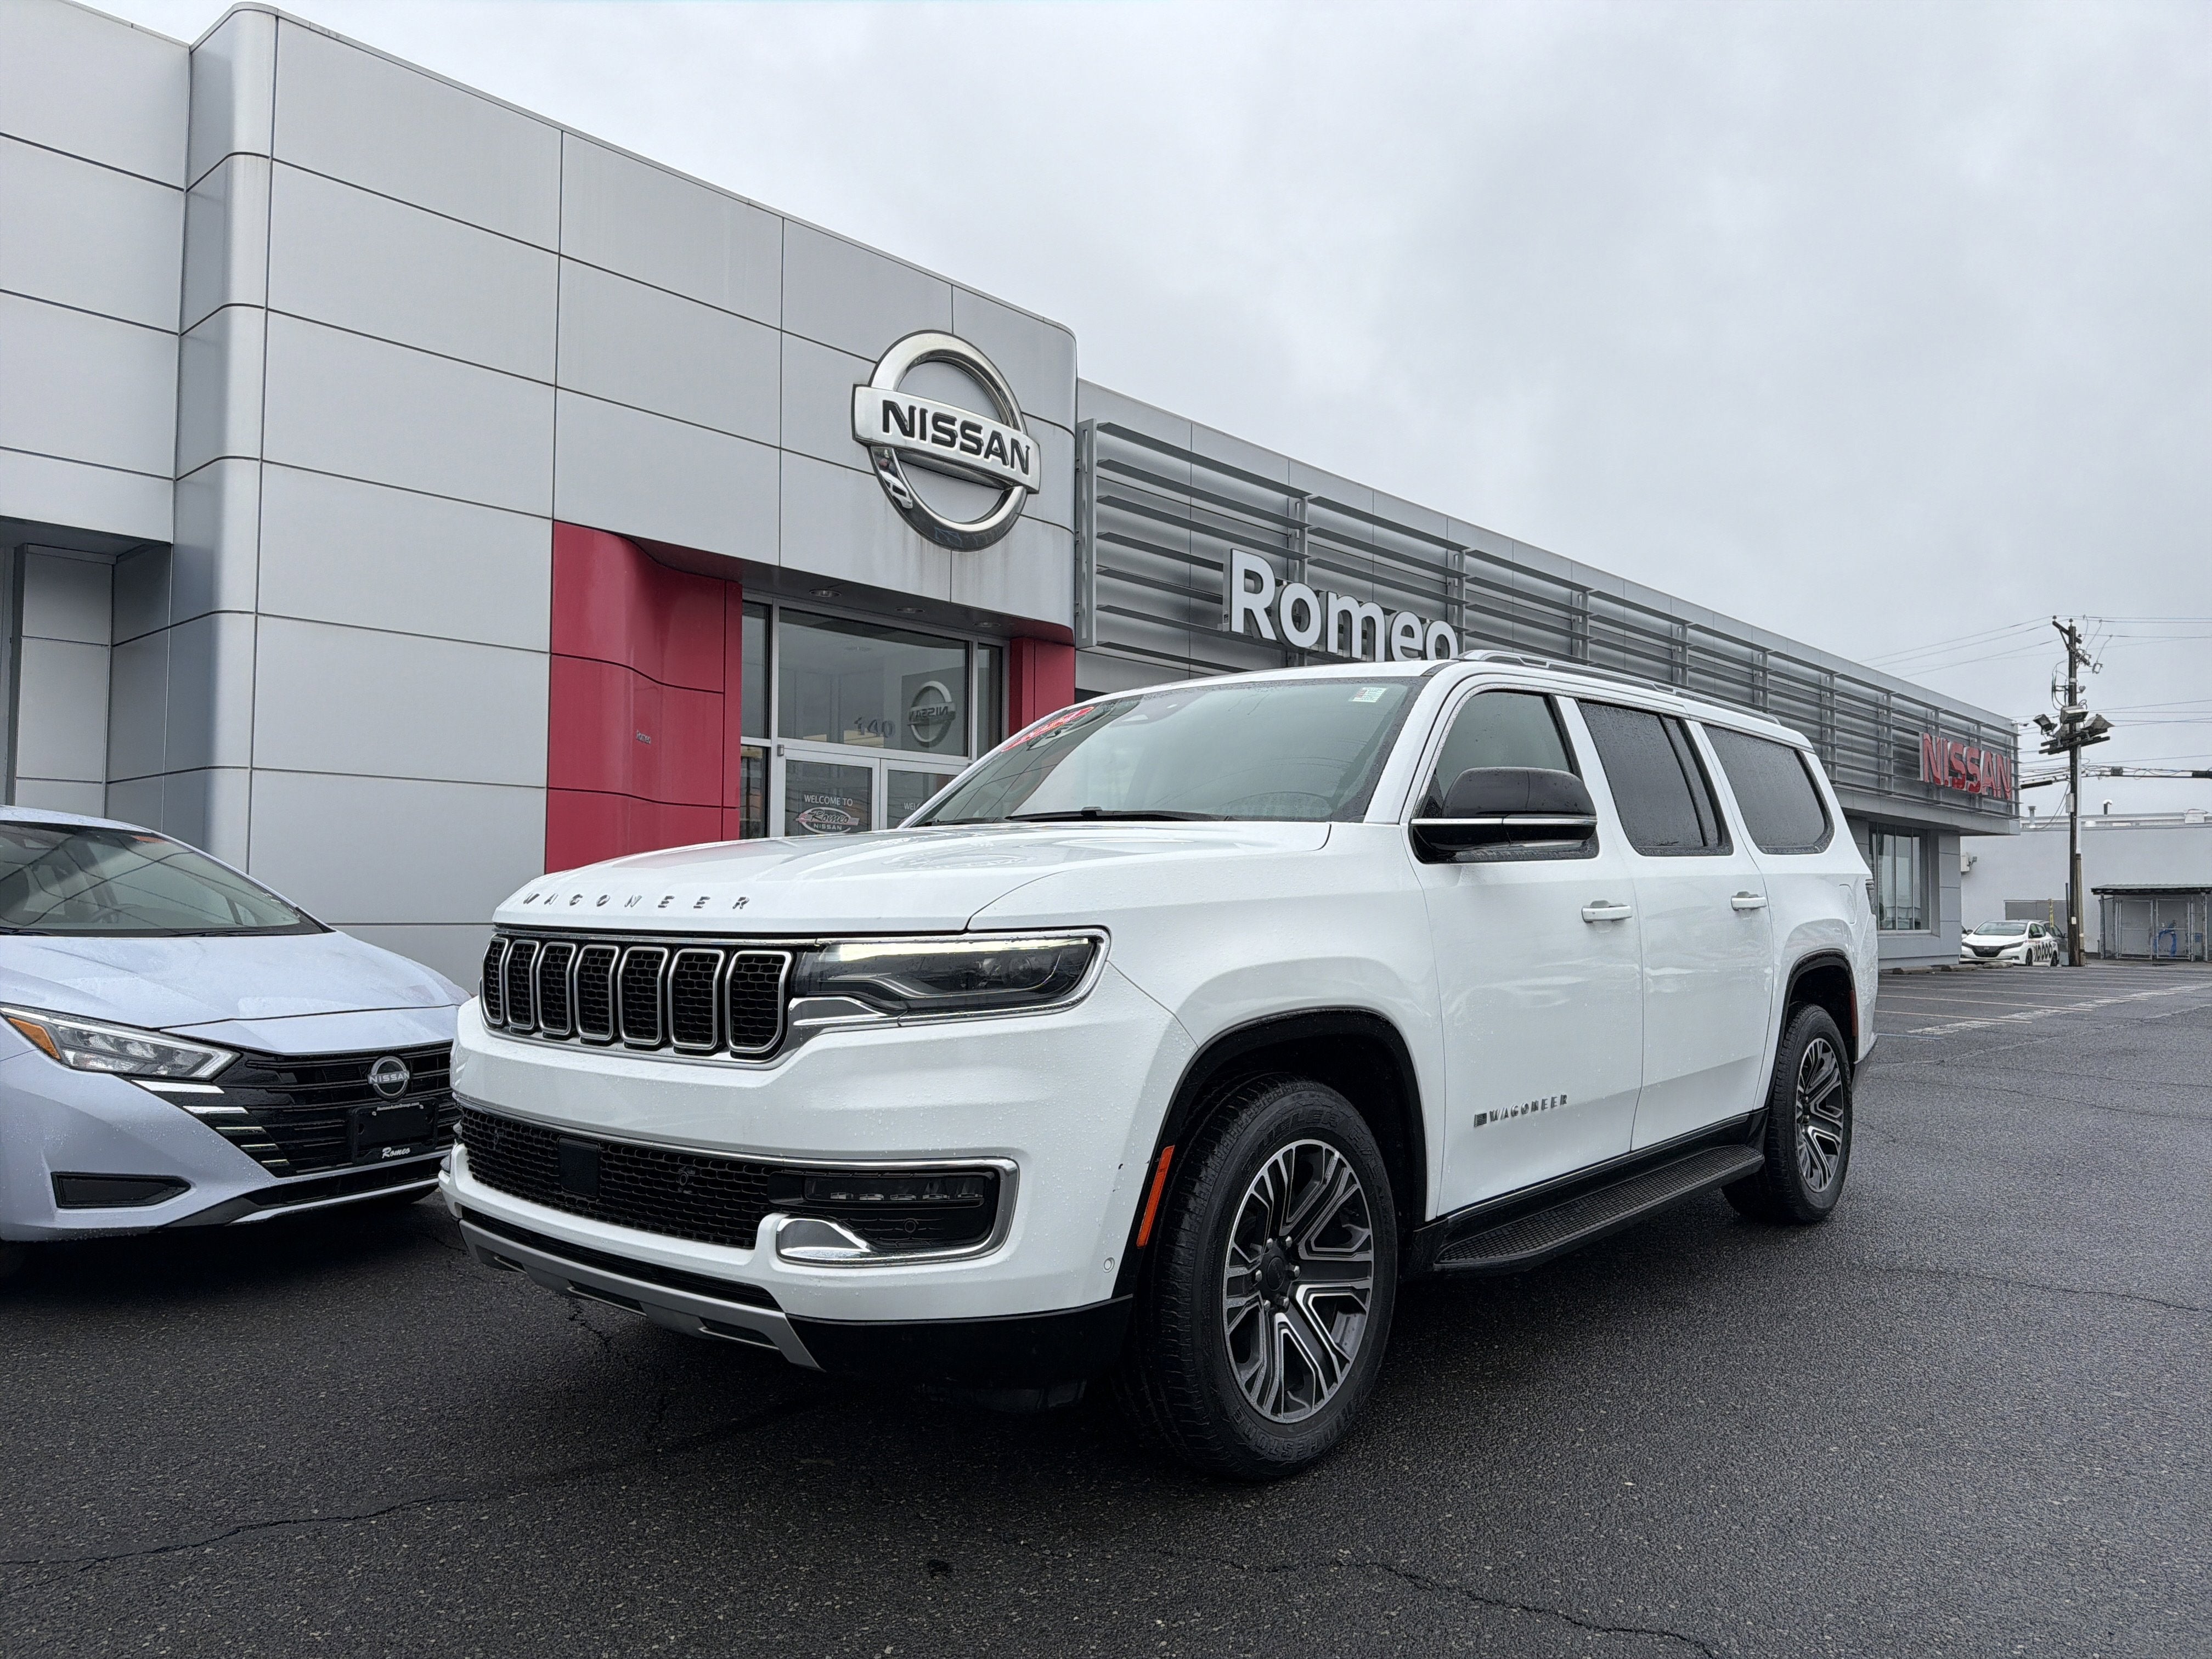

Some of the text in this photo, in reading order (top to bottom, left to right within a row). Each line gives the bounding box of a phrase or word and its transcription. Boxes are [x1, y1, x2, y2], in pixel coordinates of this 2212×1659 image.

[882, 399, 1030, 476] NISSAN
[1231, 549, 1458, 662] Romeo
[1922, 732, 2011, 800] NISSAN
[804, 794, 853, 806] WELCOME TO
[808, 809, 849, 823] Romeo
[523, 893, 750, 910] WAGONEER
[369, 1073, 410, 1083] NISSAN
[1489, 1094, 1568, 1122] WAGONEER
[382, 1147, 411, 1159] Romeo
